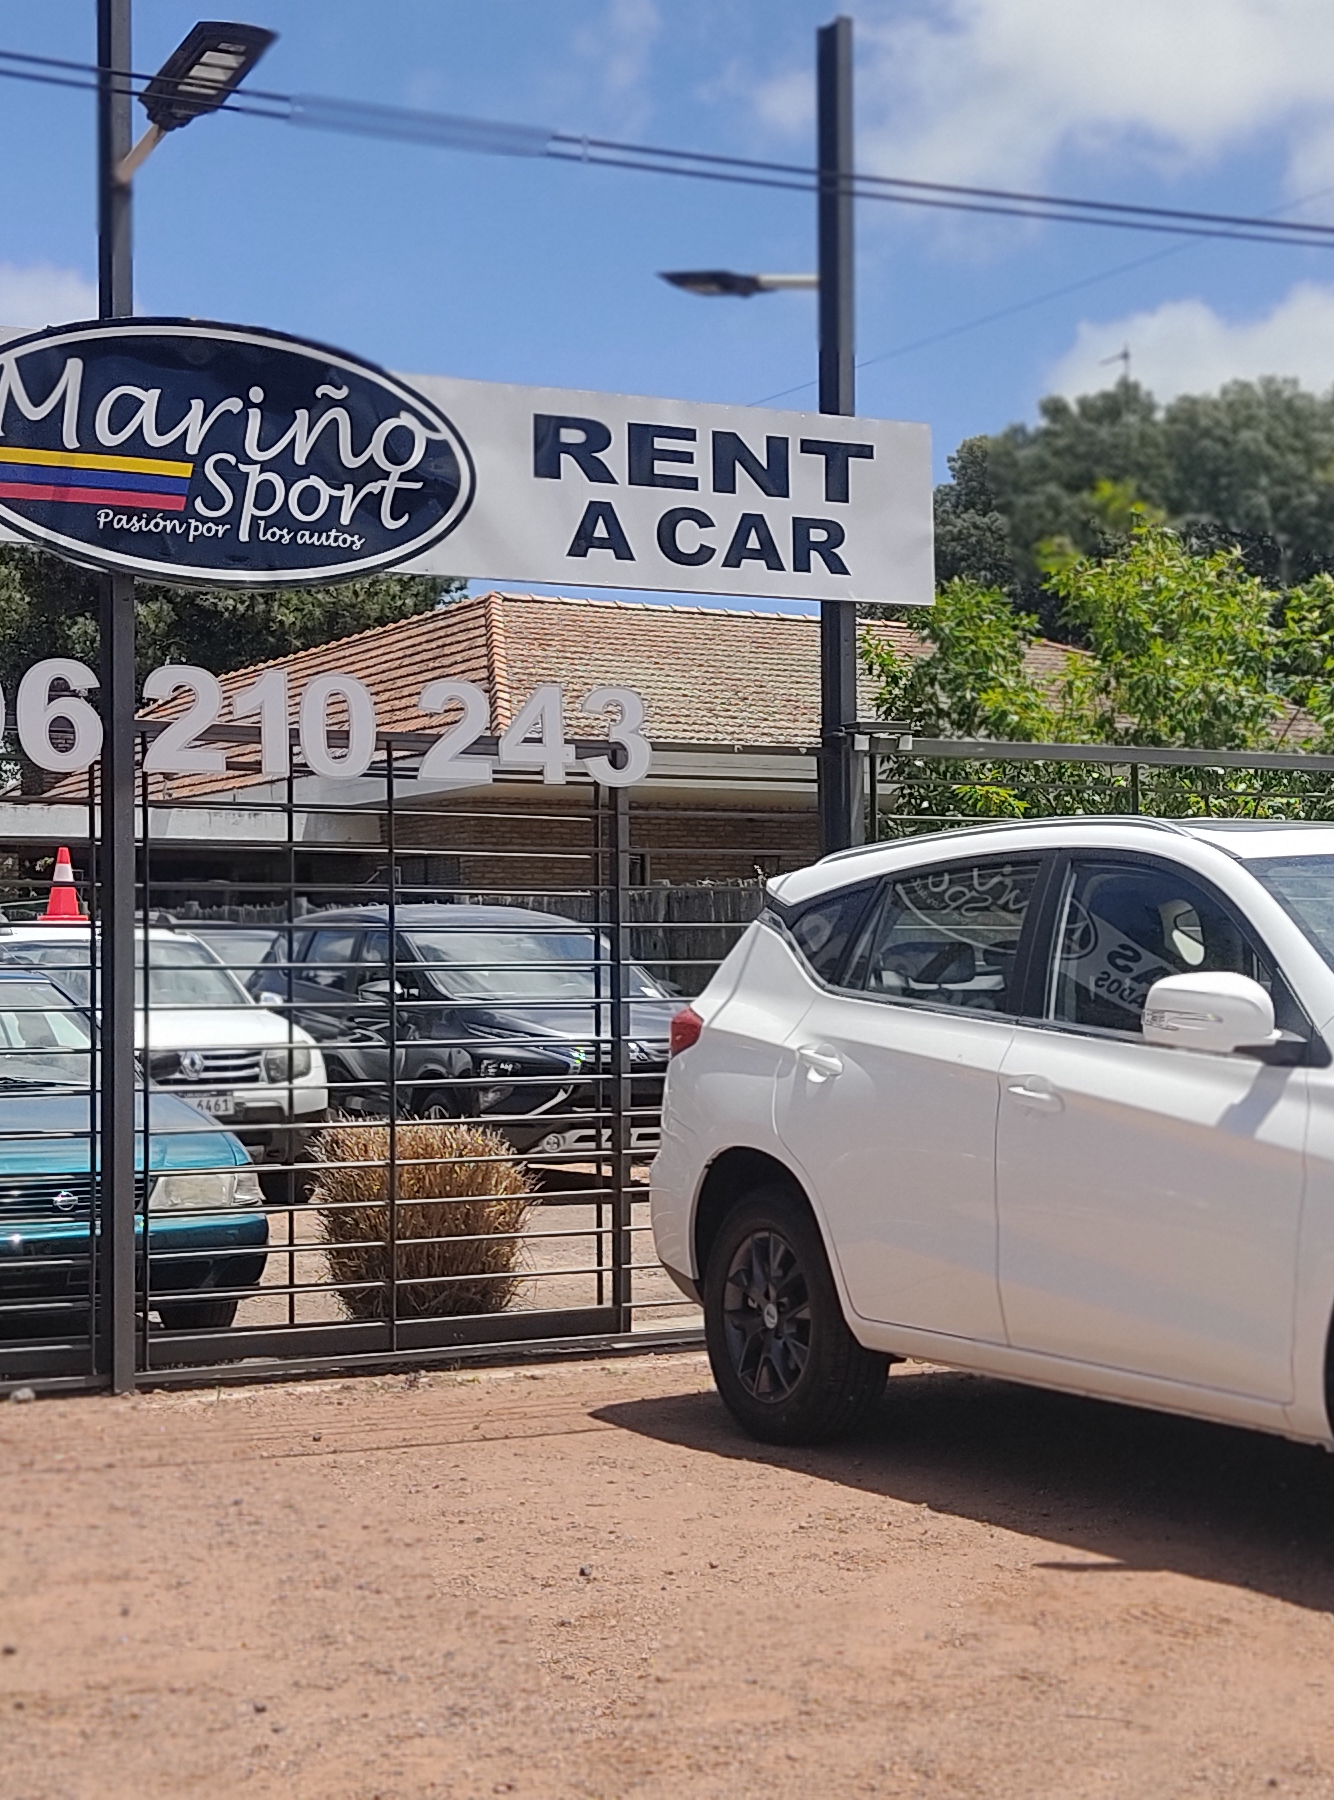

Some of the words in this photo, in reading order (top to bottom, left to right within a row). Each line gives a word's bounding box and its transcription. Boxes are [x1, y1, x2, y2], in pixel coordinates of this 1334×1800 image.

[193, 452, 424, 543] Sport
[533, 413, 875, 504] RENT
[96, 508, 188, 534] Pasión
[188, 518, 231, 543] por
[257, 519, 295, 545] los
[296, 526, 366, 550] autos
[565, 500, 636, 562] A
[656, 506, 852, 577] CAR
[141, 664, 378, 781] 210
[417, 678, 653, 788] 243
